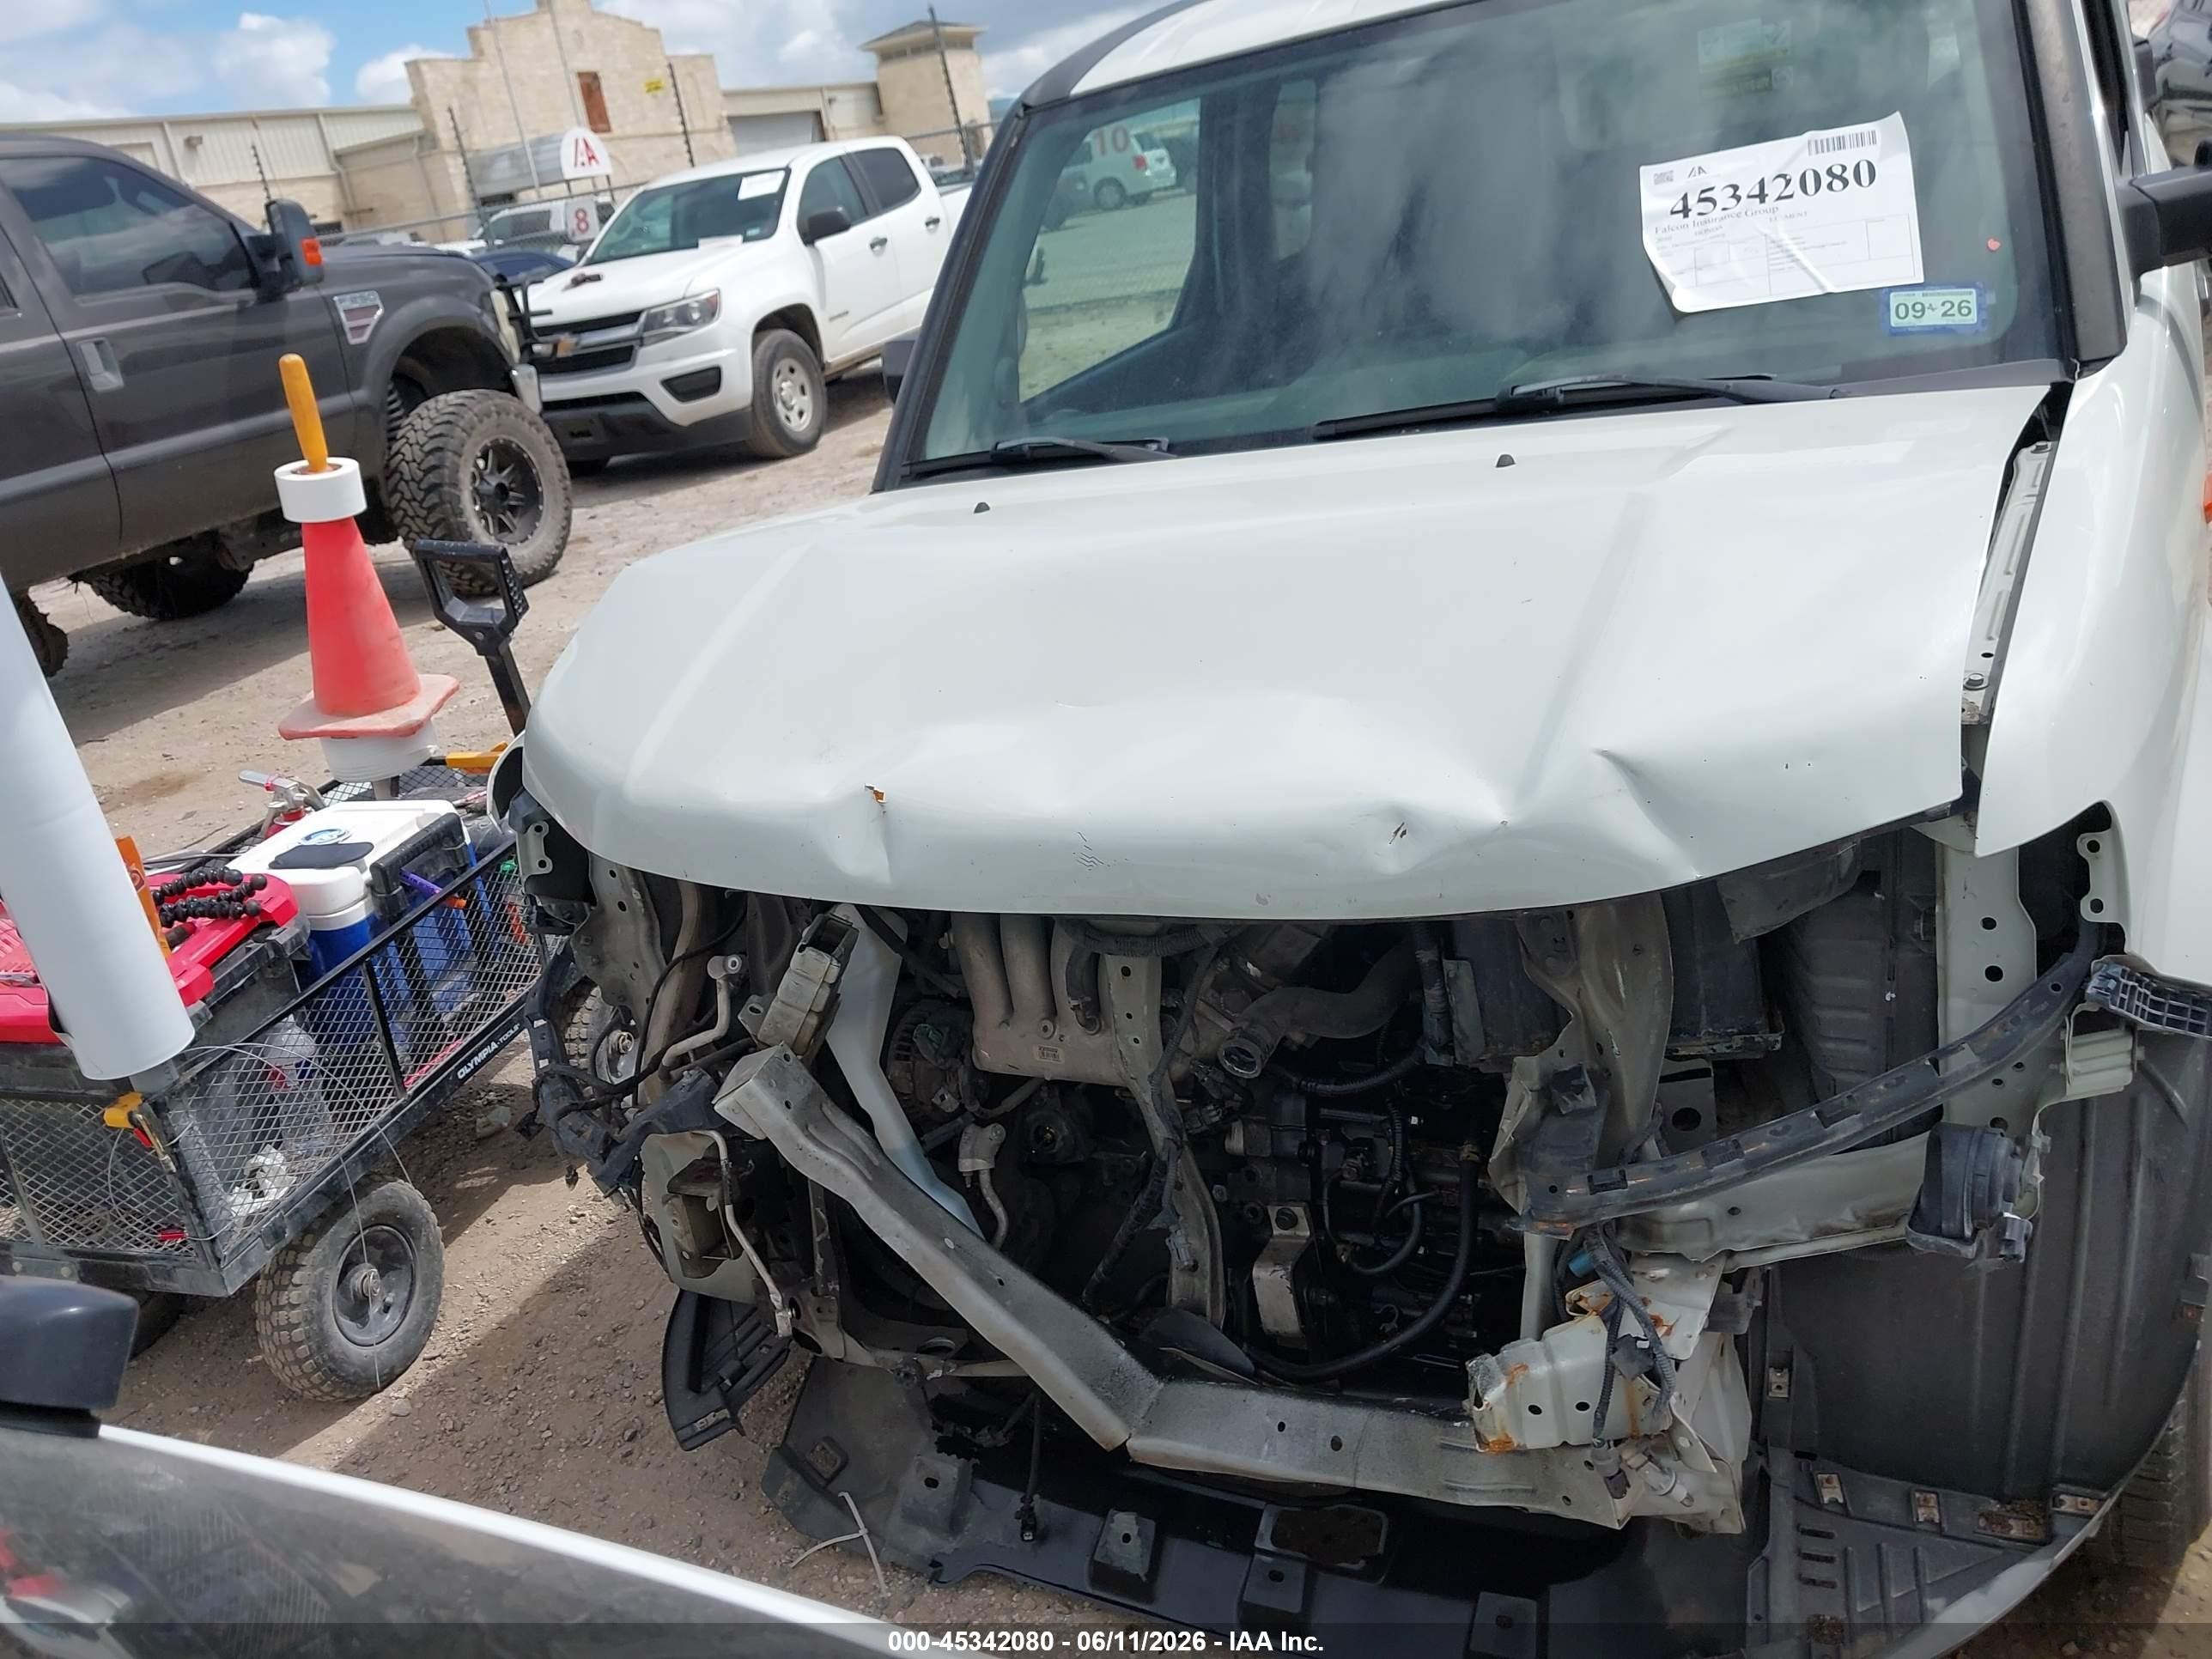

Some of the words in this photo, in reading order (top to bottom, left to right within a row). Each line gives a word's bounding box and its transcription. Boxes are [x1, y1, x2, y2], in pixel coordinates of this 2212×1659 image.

[1669, 158, 1877, 219] 45342080
[575, 208, 589, 234] 8
[1655, 222, 1690, 234] Falcon
[1744, 205, 1779, 217] Group
[1895, 301, 1926, 320] 09
[1941, 299, 1972, 318] 26
[457, 1041, 498, 1079] OLYMPIA
